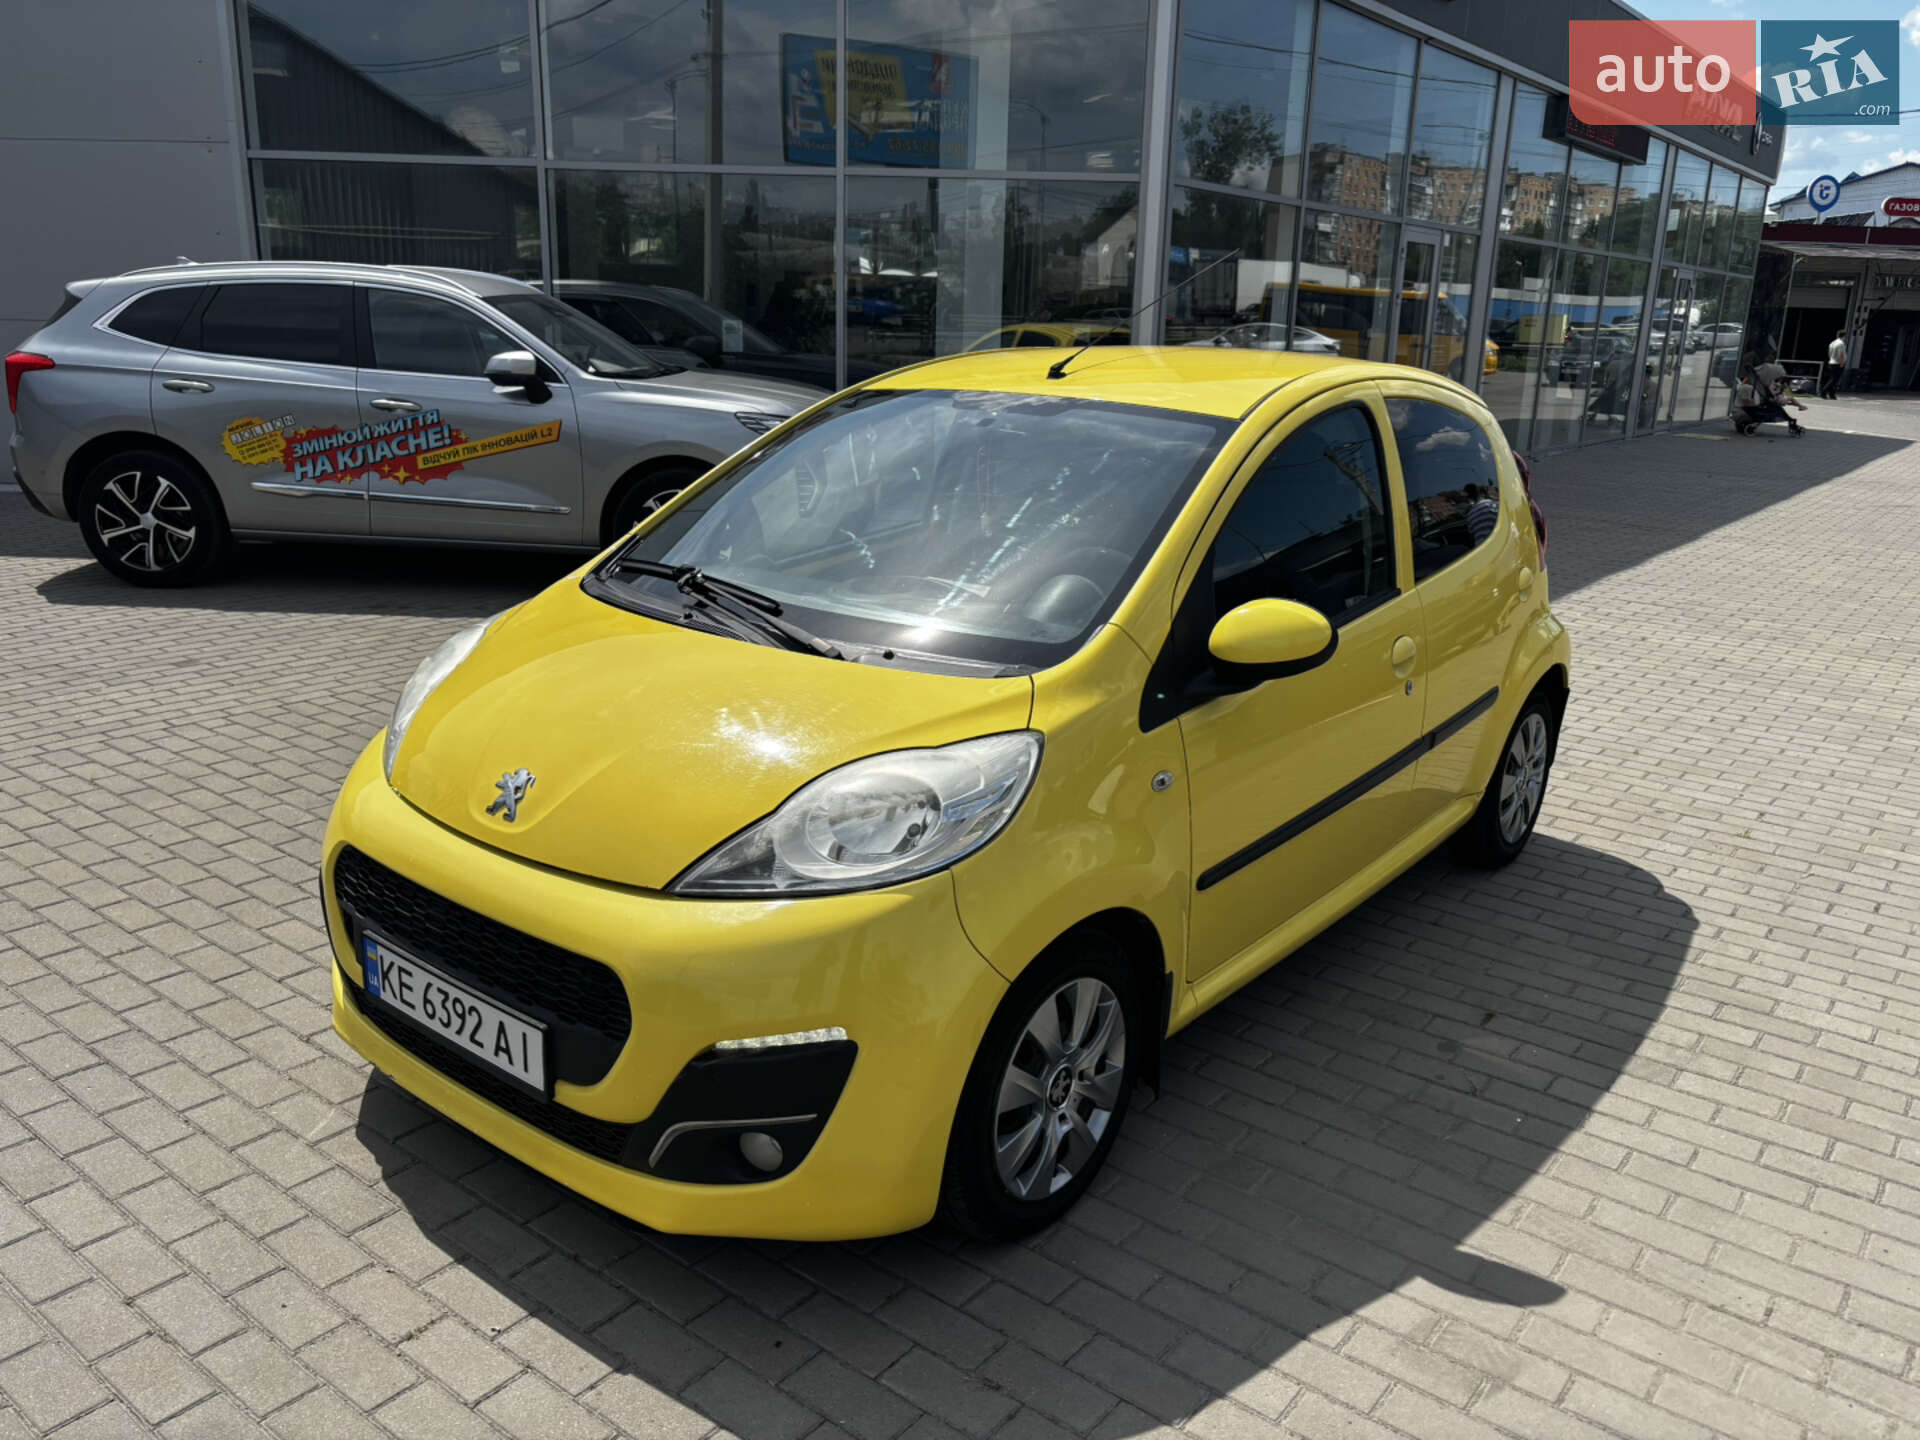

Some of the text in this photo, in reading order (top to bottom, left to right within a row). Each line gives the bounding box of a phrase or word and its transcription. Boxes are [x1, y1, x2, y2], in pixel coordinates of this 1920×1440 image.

[291, 423, 372, 458] ЗМІНЮЙ
[373, 408, 440, 438] ЖИТТЯ
[294, 424, 452, 482] НА КЛАСНЕ!
[421, 447, 460, 465] ВІДЧУЙ
[461, 446, 479, 457] ПІК
[480, 430, 538, 452] ІННОВАЦІЙ
[379, 954, 529, 1073] KE 6392 AI
